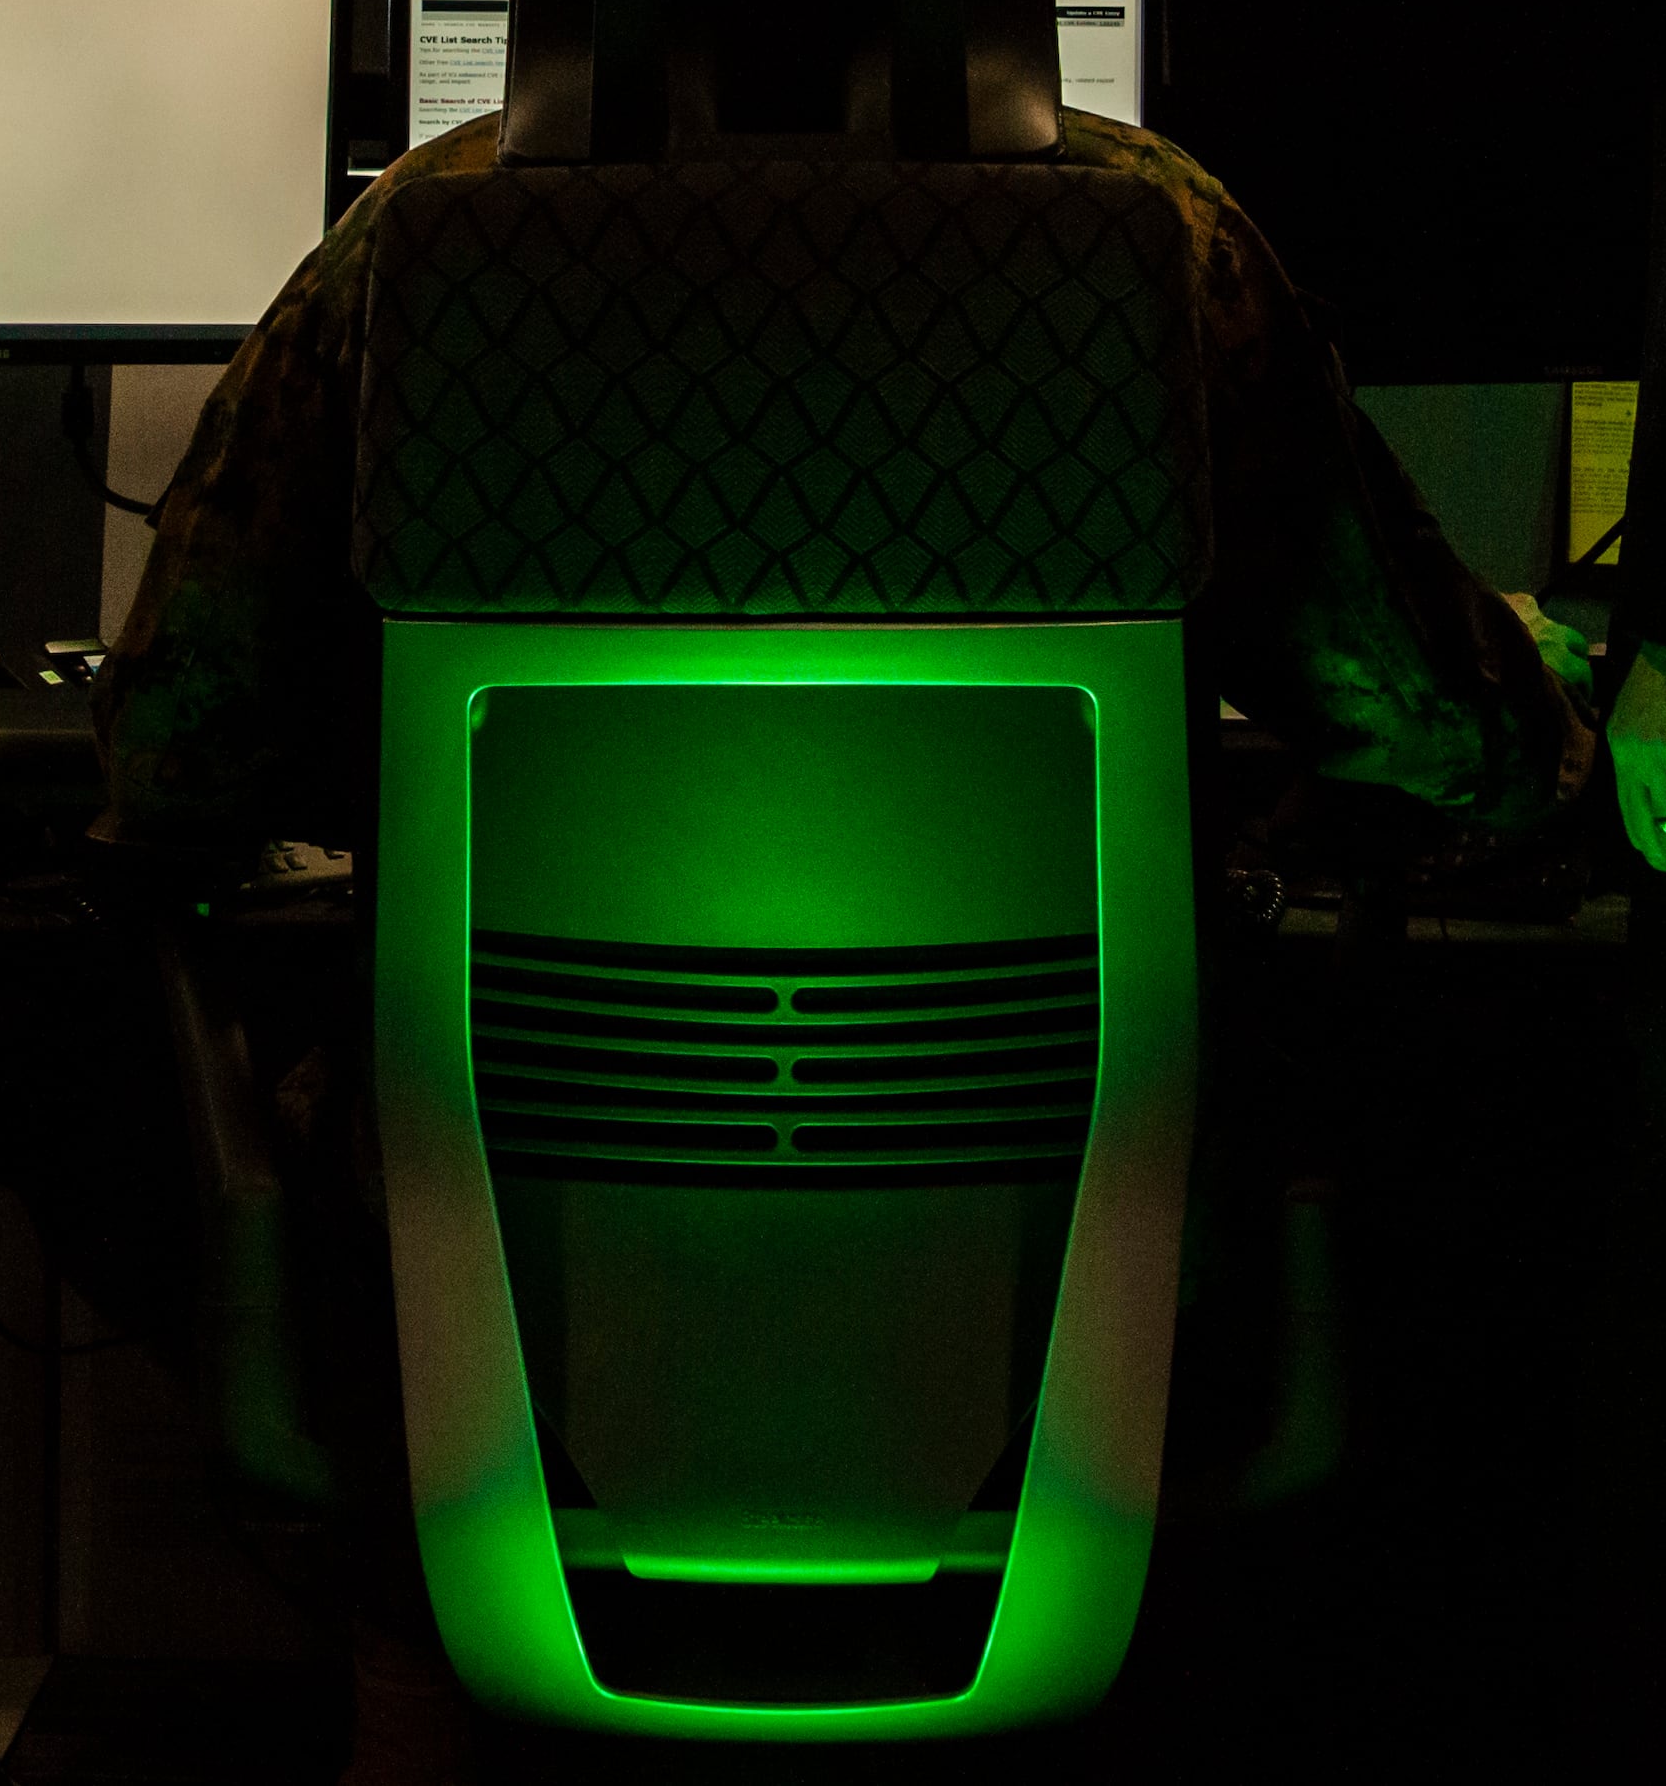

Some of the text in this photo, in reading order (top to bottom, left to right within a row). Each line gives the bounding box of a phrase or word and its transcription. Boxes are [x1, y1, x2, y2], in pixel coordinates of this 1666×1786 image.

[419, 36, 439, 44] CVE
[441, 36, 458, 44] List
[461, 36, 493, 44] Search
